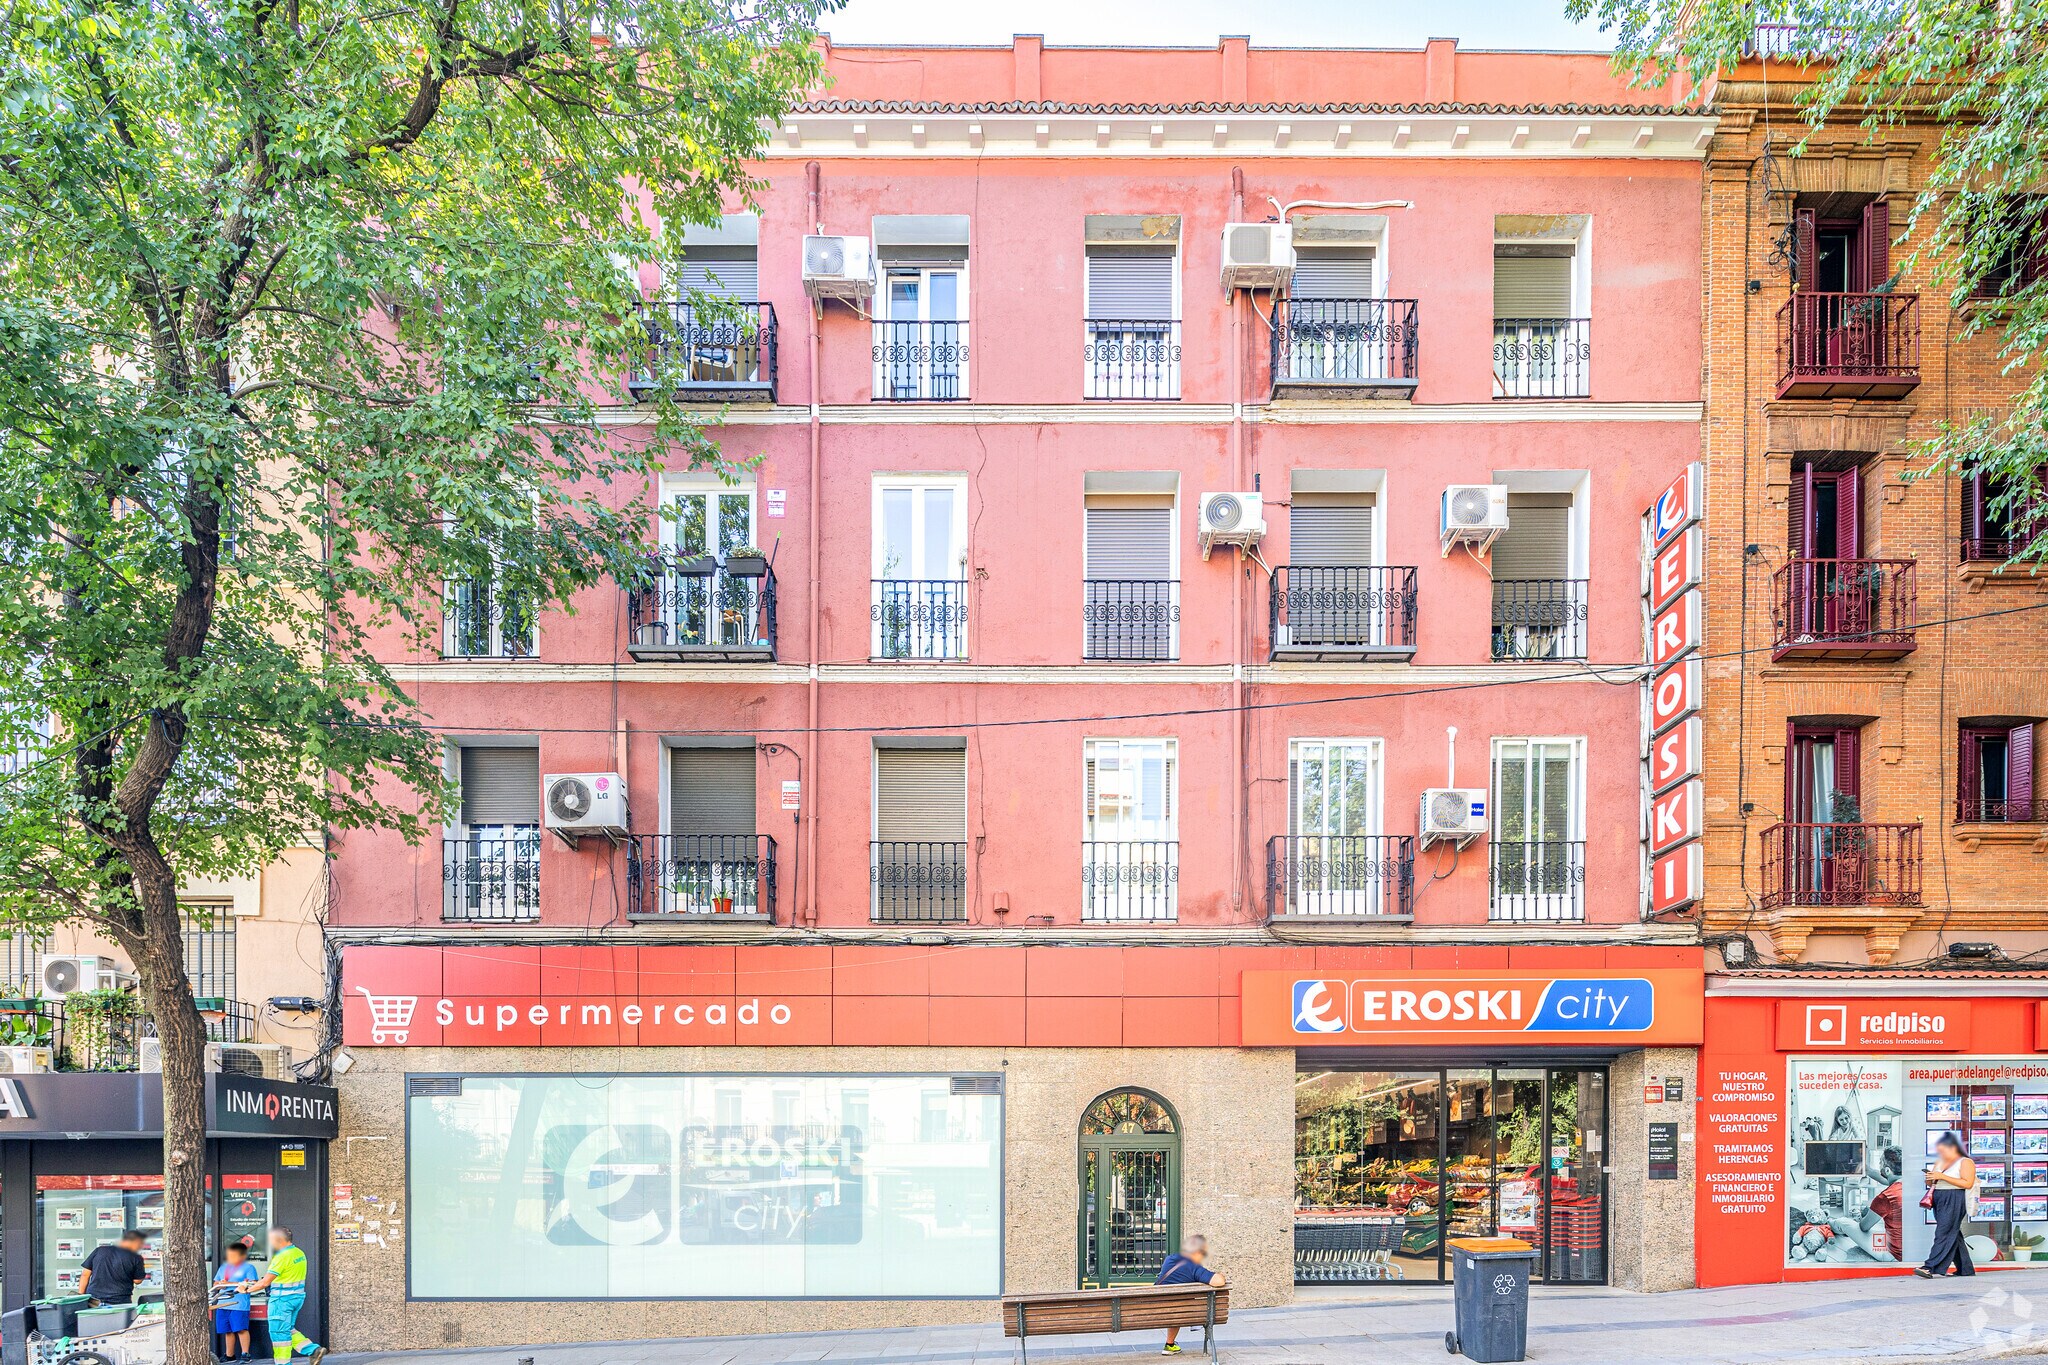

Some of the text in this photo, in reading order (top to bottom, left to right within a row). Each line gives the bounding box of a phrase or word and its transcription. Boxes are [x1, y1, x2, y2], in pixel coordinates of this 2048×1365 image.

[1656, 544, 1683, 901] EROSKI
[597, 792, 609, 800] LG
[1363, 987, 1630, 1026] EROSKI city
[435, 998, 792, 1031] Supermercado
[1860, 1012, 1946, 1035] redpiso
[1859, 1037, 1944, 1045] Servicios Inmobiliarios
[1719, 1071, 1768, 1082] TU HOGAR,
[1799, 1071, 1815, 1081] Las
[1817, 1071, 1858, 1083] mejores
[1722, 1082, 1765, 1091] NUESTRO
[1799, 1081, 1883, 1090] suceden en casa.
[1712, 1093, 1775, 1102] COMPROMISO
[1709, 1113, 1778, 1122] VALORACIONES
[1121, 1122, 1135, 1134] 47
[1718, 1124, 1768, 1133] GRATUITAS
[1713, 1144, 1774, 1153] TRAMITAMOS
[1718, 1155, 1769, 1164] HERENCIAS
[1705, 1172, 1782, 1182] ASESORAMIENTO
[694, 1137, 851, 1239] EROSKI city
[1712, 1183, 1775, 1192] FINANCIERO E
[1712, 1194, 1775, 1203] INMOBILIARIO
[1721, 1204, 1767, 1213] GRATUITO
